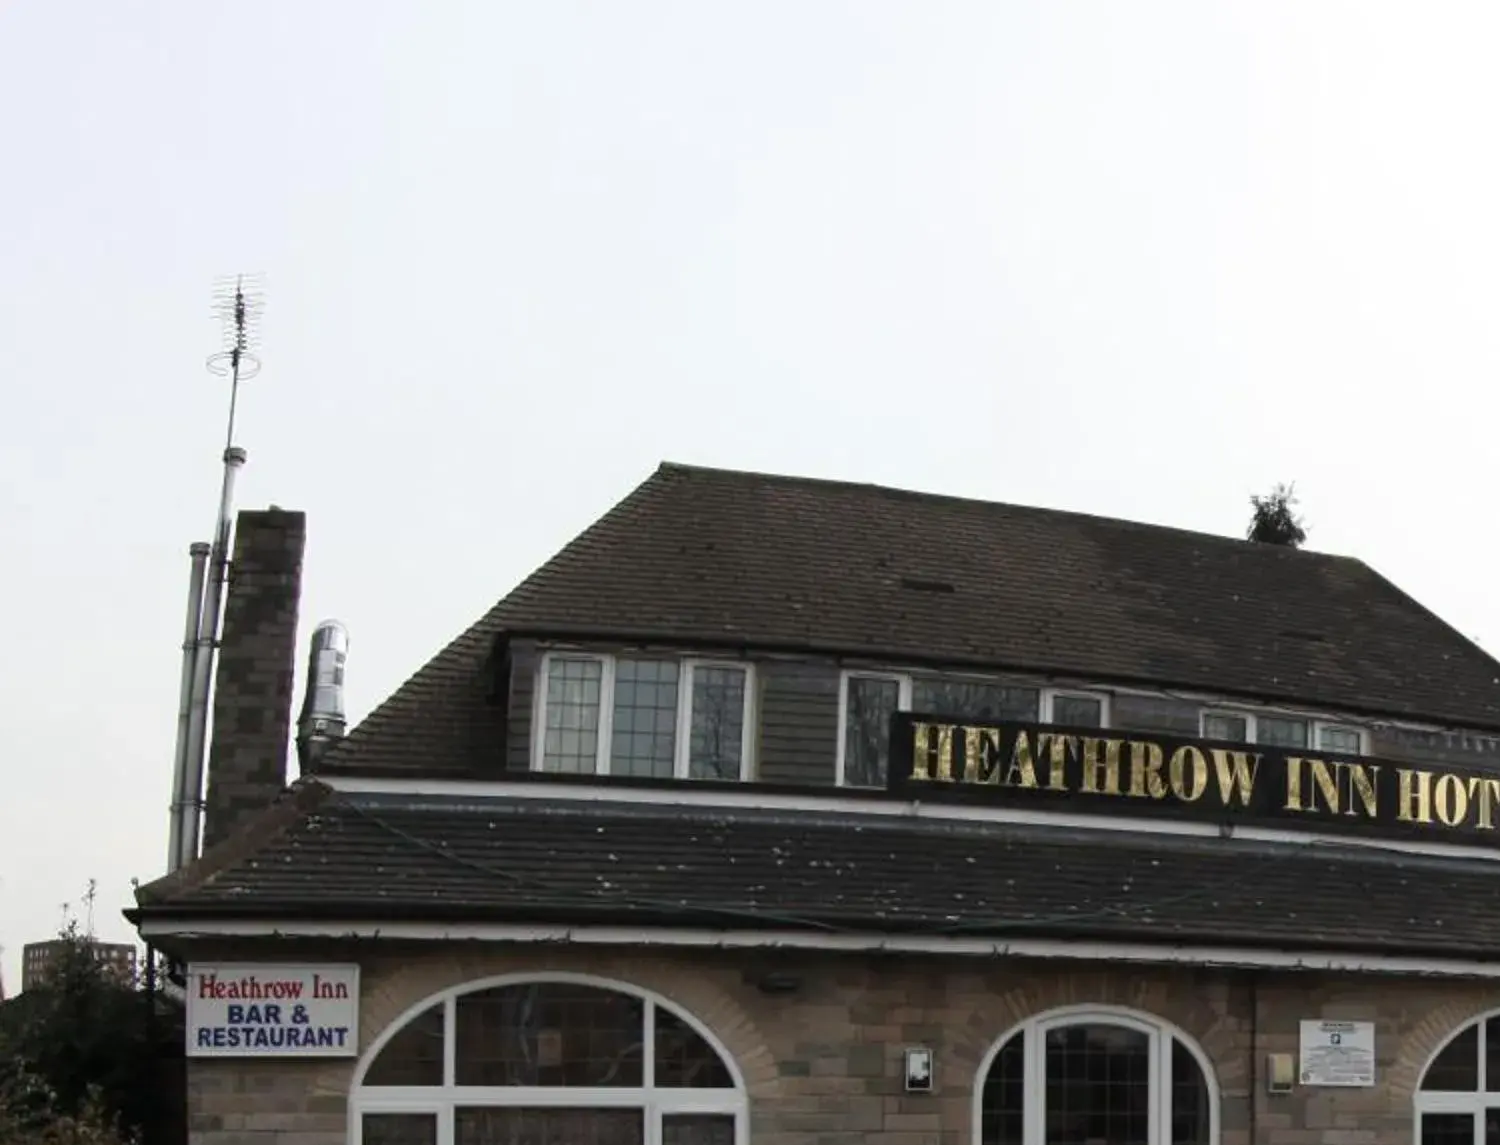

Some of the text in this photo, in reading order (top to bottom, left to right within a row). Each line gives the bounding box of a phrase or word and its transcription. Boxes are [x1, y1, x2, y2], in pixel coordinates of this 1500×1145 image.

[908, 721, 1264, 808] HEATHROW
[1284, 756, 1380, 818] INN
[199, 973, 349, 999] Heathrow Inn
[227, 1004, 310, 1025] BAR &
[198, 1027, 349, 1048] RESTAURANT
